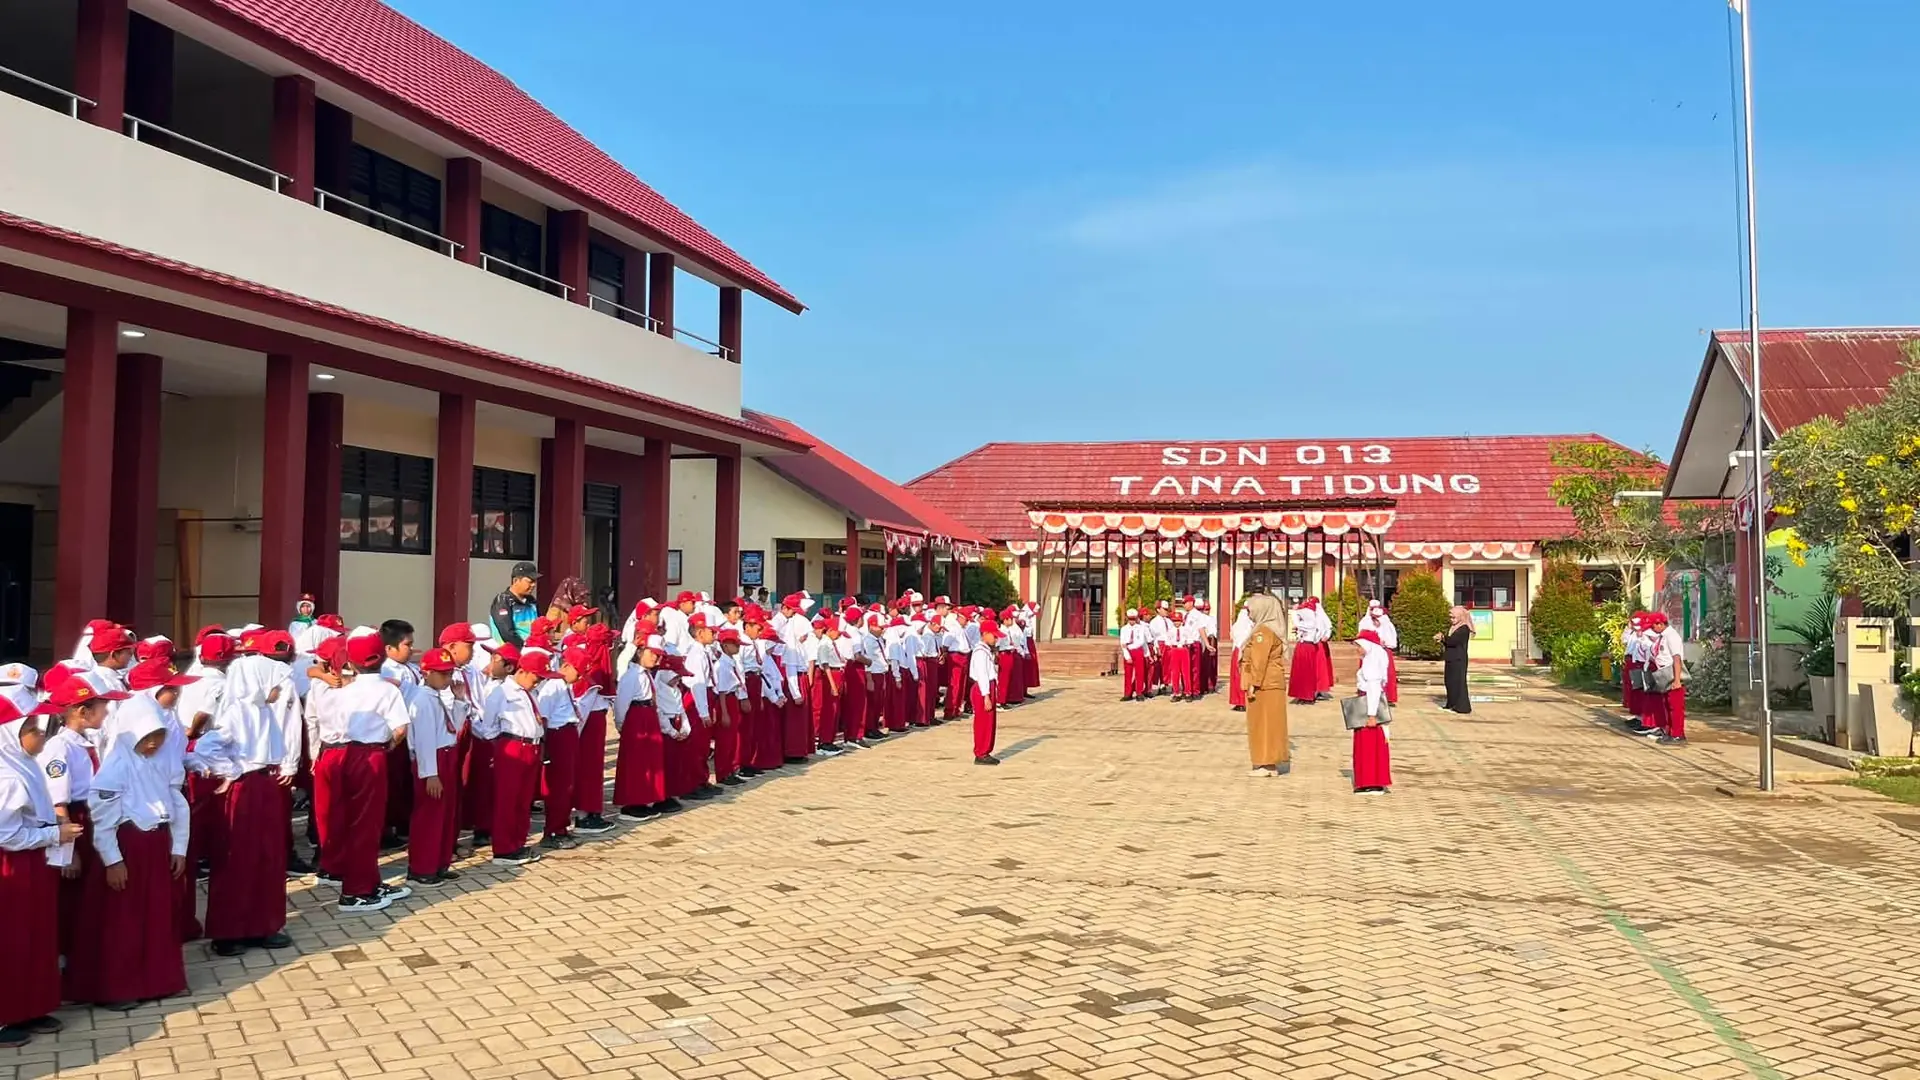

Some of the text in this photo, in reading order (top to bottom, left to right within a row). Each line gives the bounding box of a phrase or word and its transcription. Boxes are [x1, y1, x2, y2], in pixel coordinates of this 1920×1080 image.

[1162, 444, 1393, 468] SDN 013
[1110, 474, 1481, 498] TANA TIDUNG
